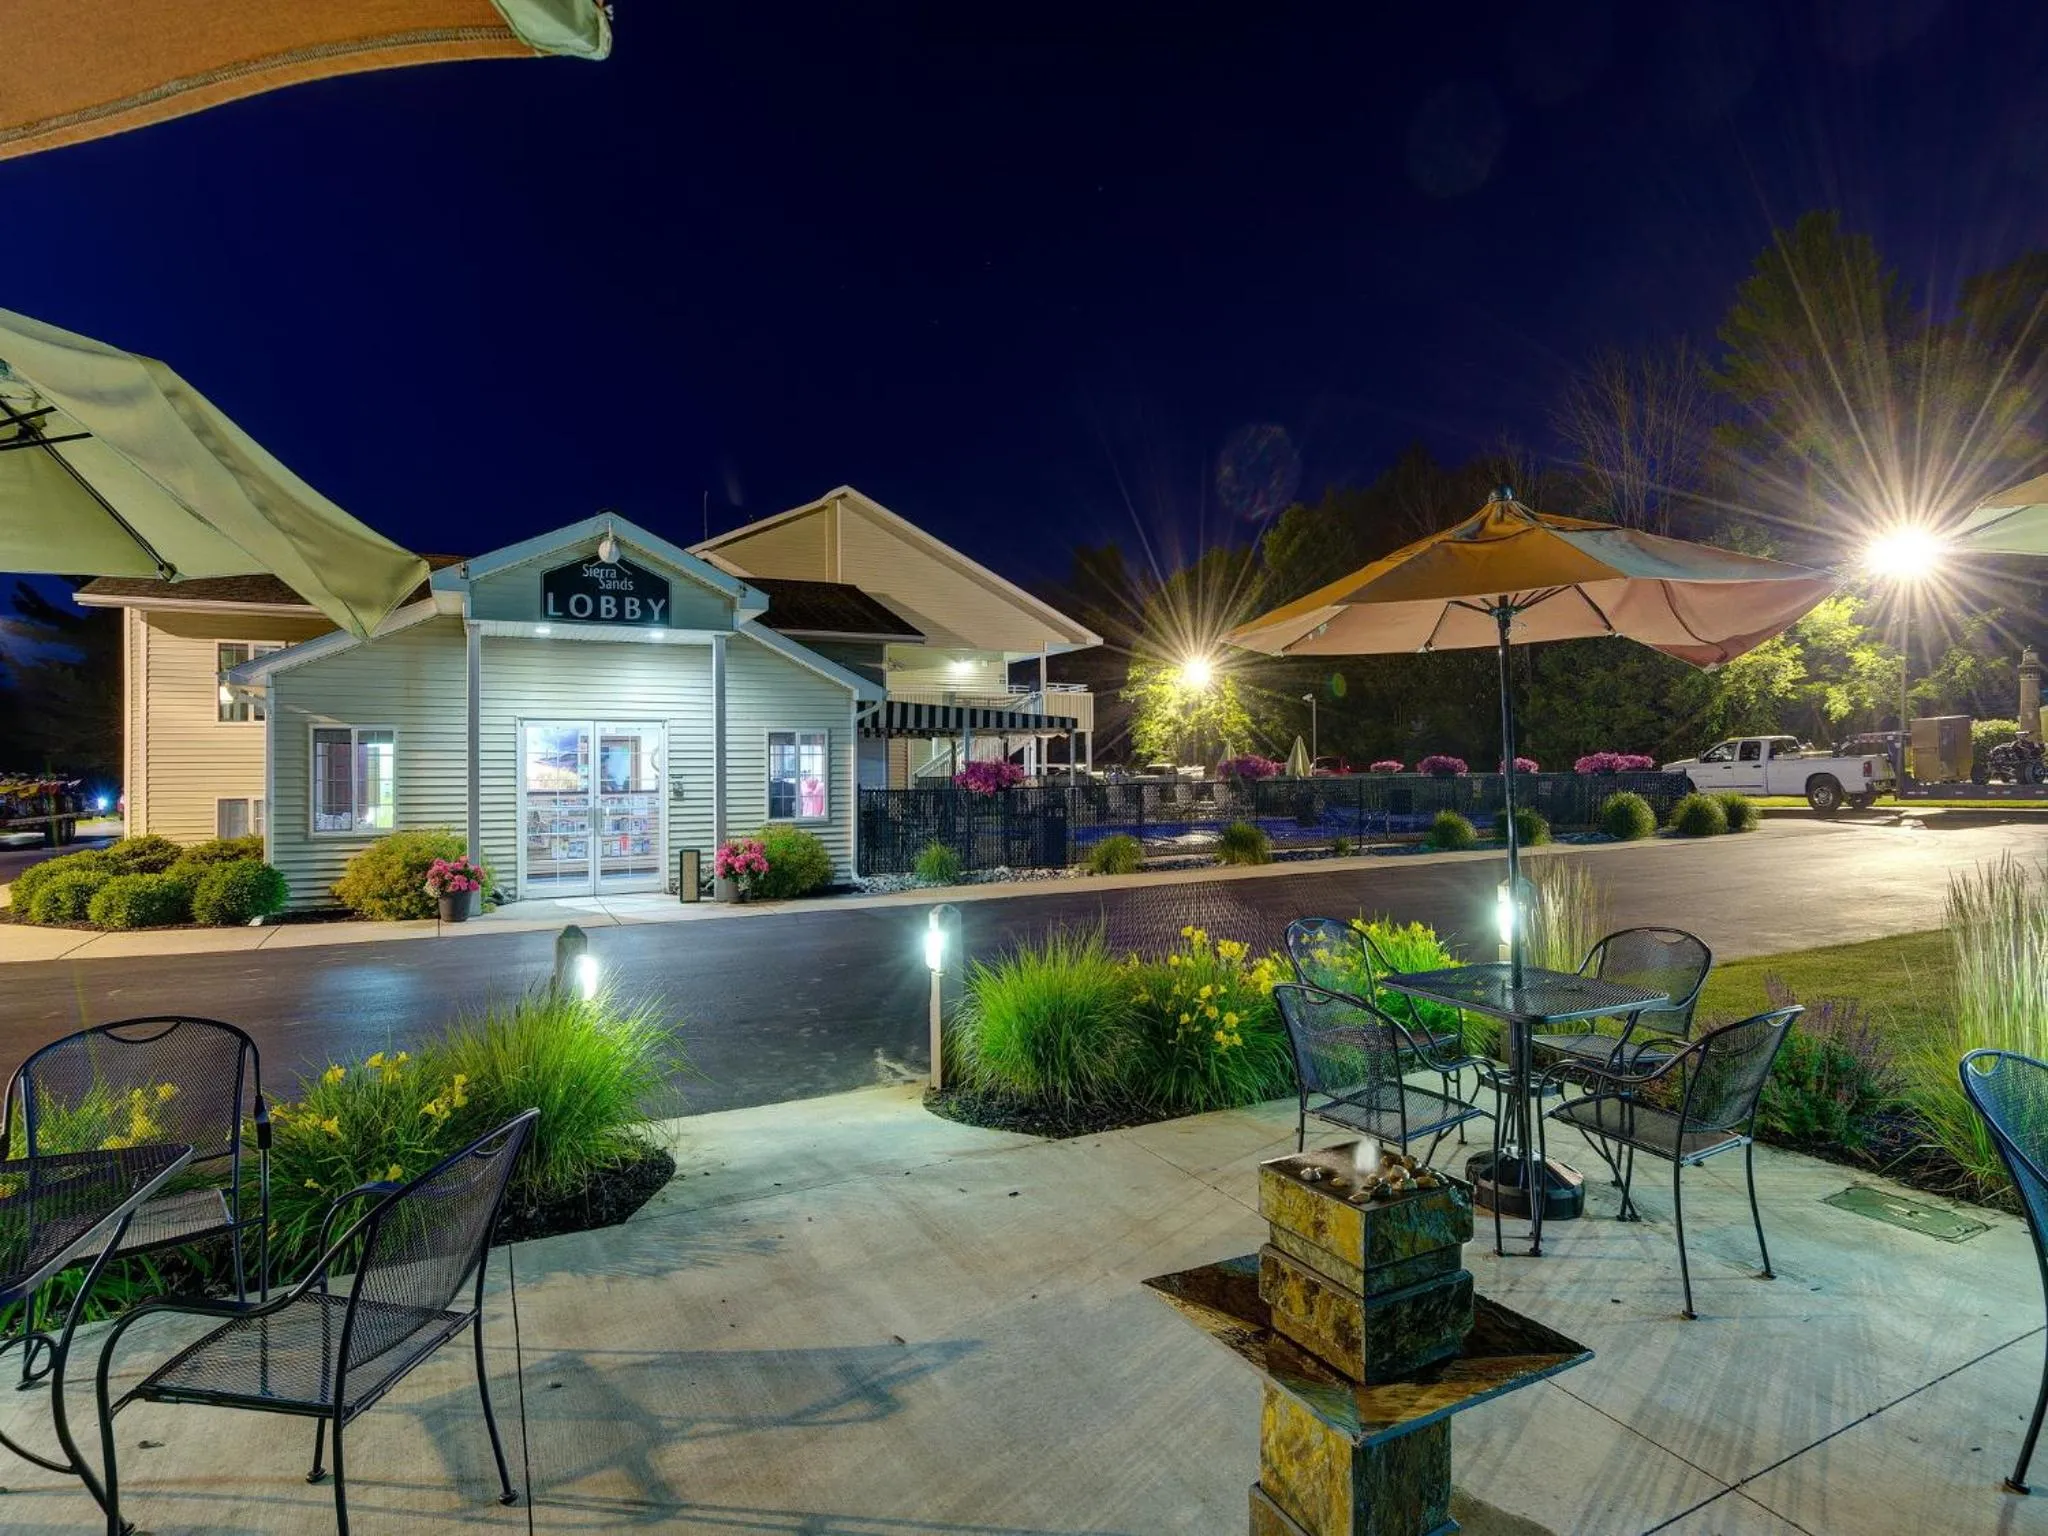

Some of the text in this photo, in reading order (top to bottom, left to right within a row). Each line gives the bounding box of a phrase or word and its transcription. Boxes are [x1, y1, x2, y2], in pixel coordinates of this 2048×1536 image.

[582, 563, 617, 578] Sierra
[599, 577, 634, 591] Sands
[547, 592, 666, 621] LOBBY
